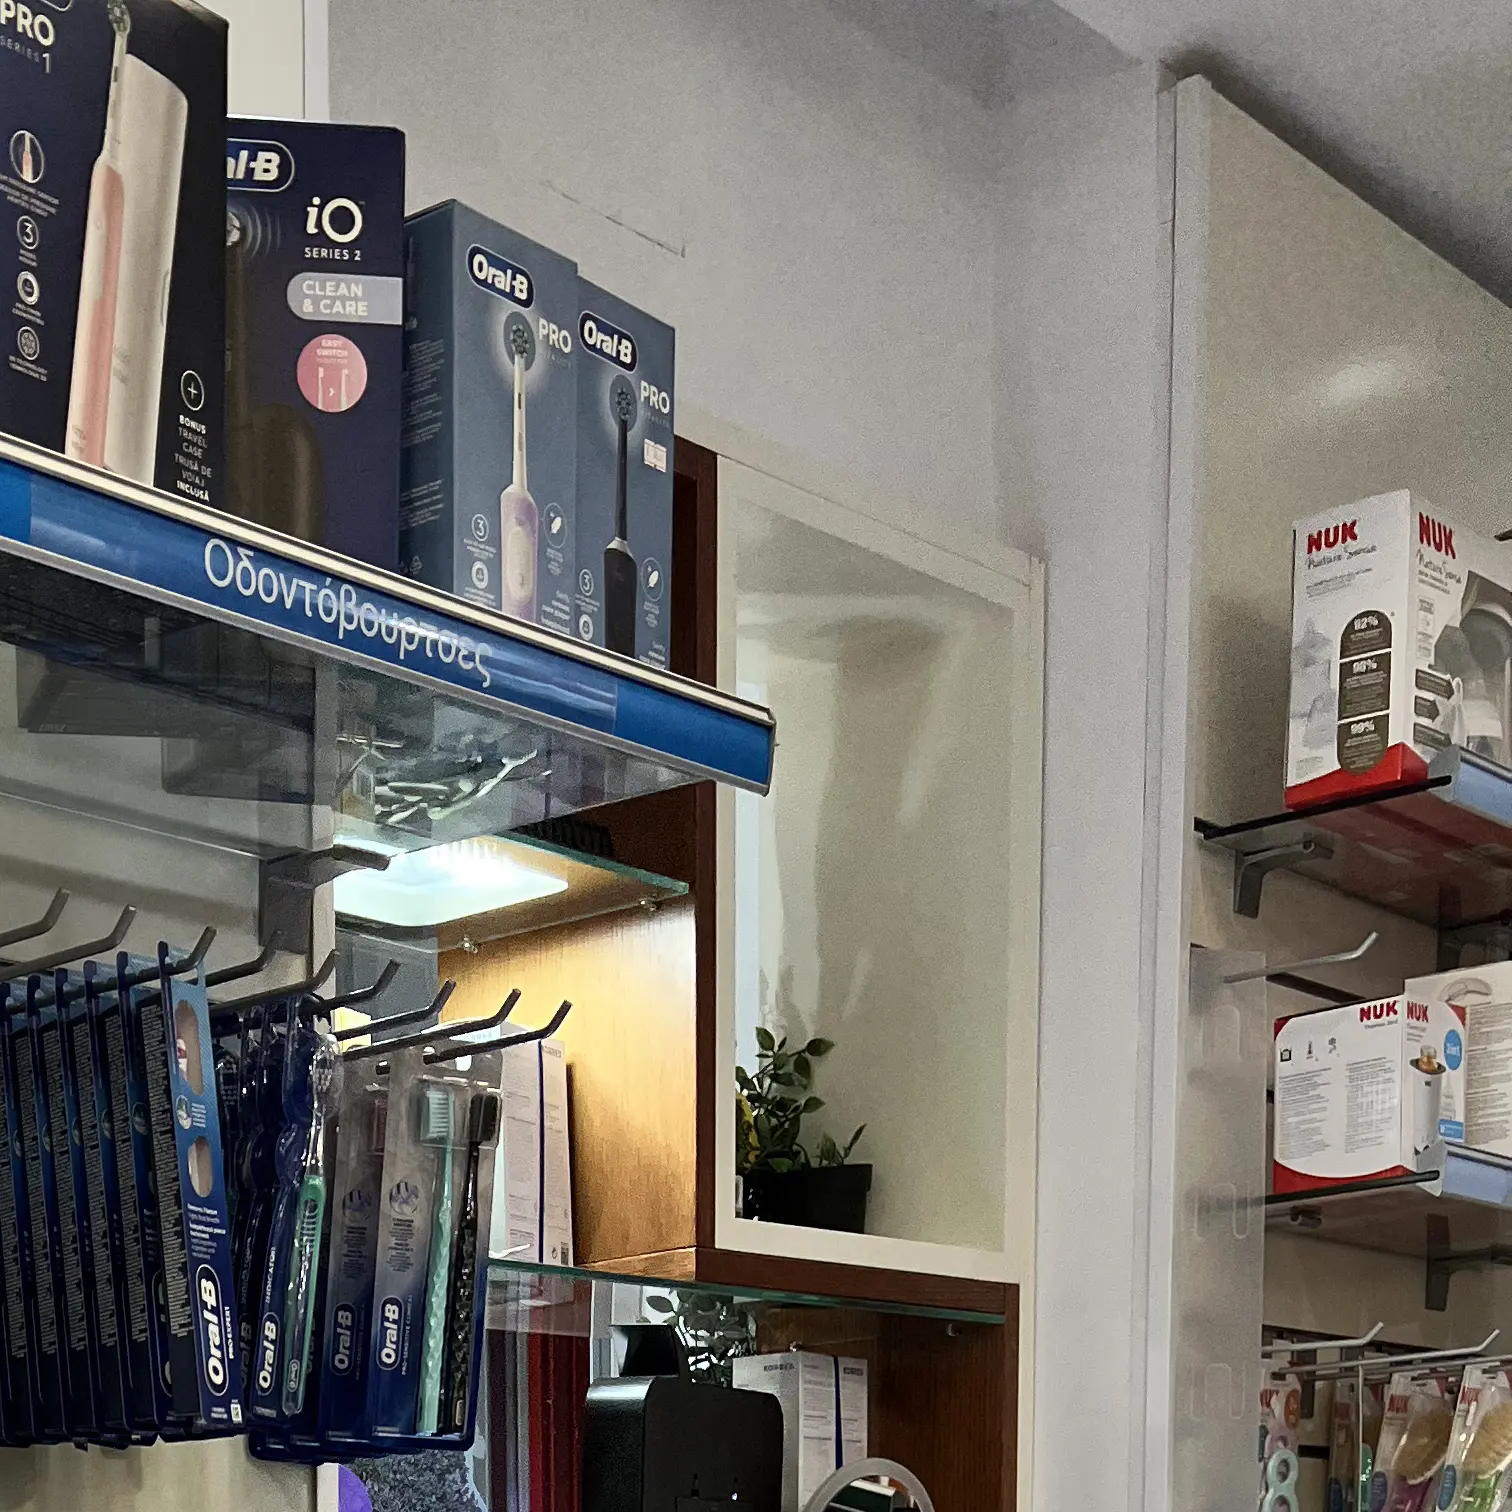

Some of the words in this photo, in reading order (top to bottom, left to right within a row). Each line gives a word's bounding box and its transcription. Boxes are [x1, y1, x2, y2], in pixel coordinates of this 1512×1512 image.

[306, 197, 363, 243] iO
[304, 247, 349, 260] SERIES
[354, 250, 361, 260] 2
[302, 280, 363, 298] CLEAN
[473, 252, 529, 300] Oral-B
[302, 299, 314, 313] &
[319, 299, 369, 316] CARE
[539, 318, 572, 354] PRO
[584, 320, 633, 364] Oral-B
[641, 380, 670, 414] PRO
[179, 414, 206, 434] BONUS
[1307, 520, 1358, 555] NUK
[1419, 511, 1457, 560] NUK
[204, 539, 491, 688] Οδοντόβουρτσες
[1359, 1000, 1399, 1023] NUK
[1406, 1000, 1429, 1024] NUK
[199, 1278, 224, 1386] Oral-B
[380, 1303, 400, 1364] Oral-B
[259, 1319, 278, 1389] Oral-B
